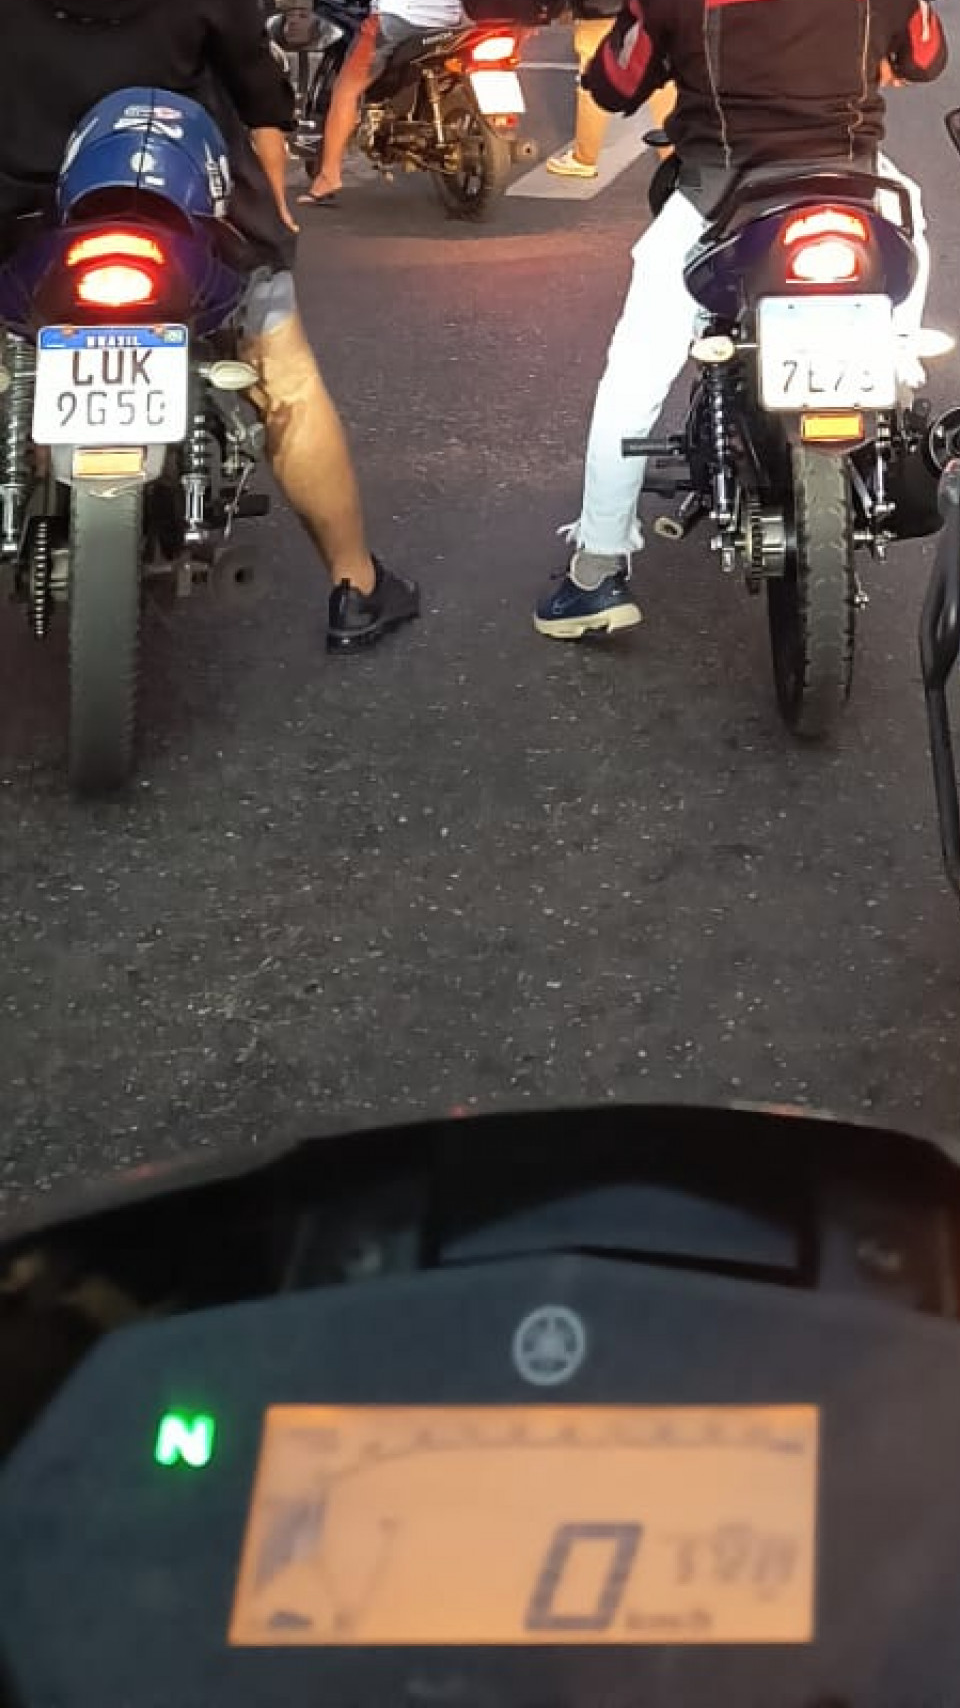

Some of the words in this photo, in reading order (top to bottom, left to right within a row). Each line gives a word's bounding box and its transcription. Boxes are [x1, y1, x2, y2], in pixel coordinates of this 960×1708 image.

[72, 349, 152, 386] LUK
[155, 1415, 214, 1465] N
[523, 1522, 643, 1630] 0
